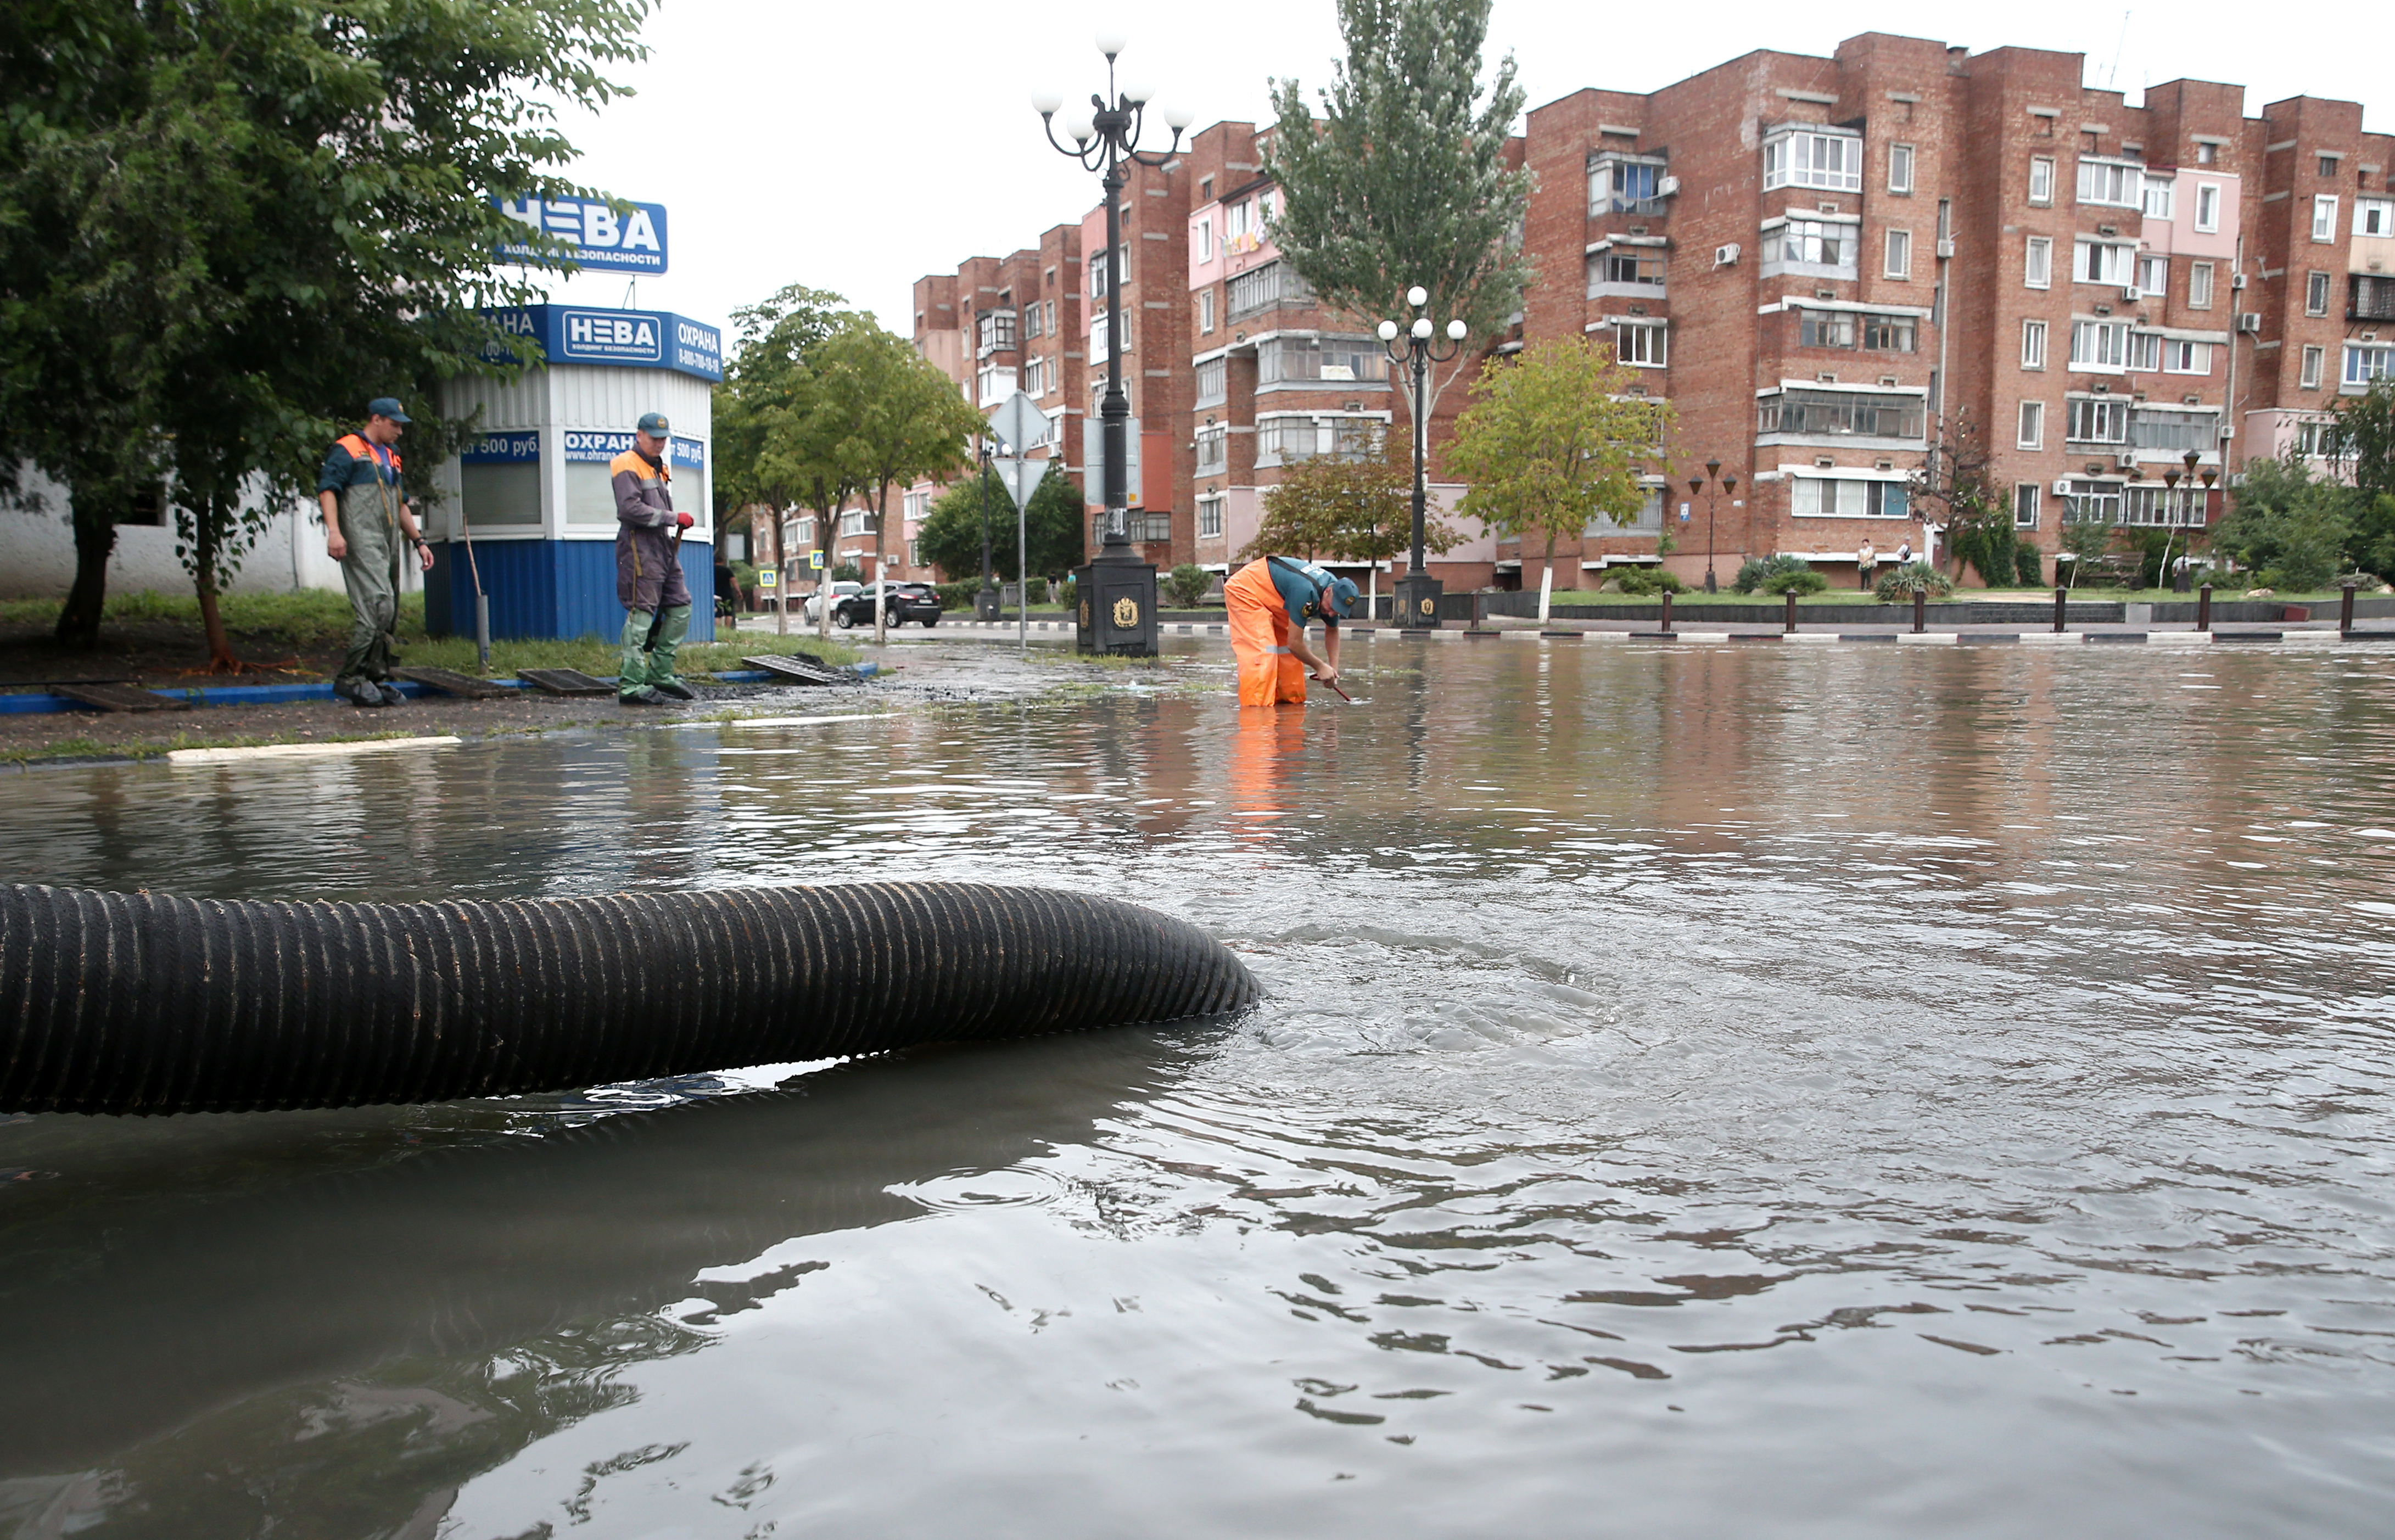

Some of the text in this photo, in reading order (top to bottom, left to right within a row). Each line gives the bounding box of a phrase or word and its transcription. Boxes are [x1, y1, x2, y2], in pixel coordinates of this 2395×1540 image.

[502, 198, 661, 251] НЕВА
[571, 318, 656, 346] НЕВА
[678, 322, 719, 354] ОХРАНА
[480, 438, 508, 454] 500
[513, 436, 540, 456] руб.
[566, 433, 635, 450] ОХРАН
[676, 442, 690, 458] 500
